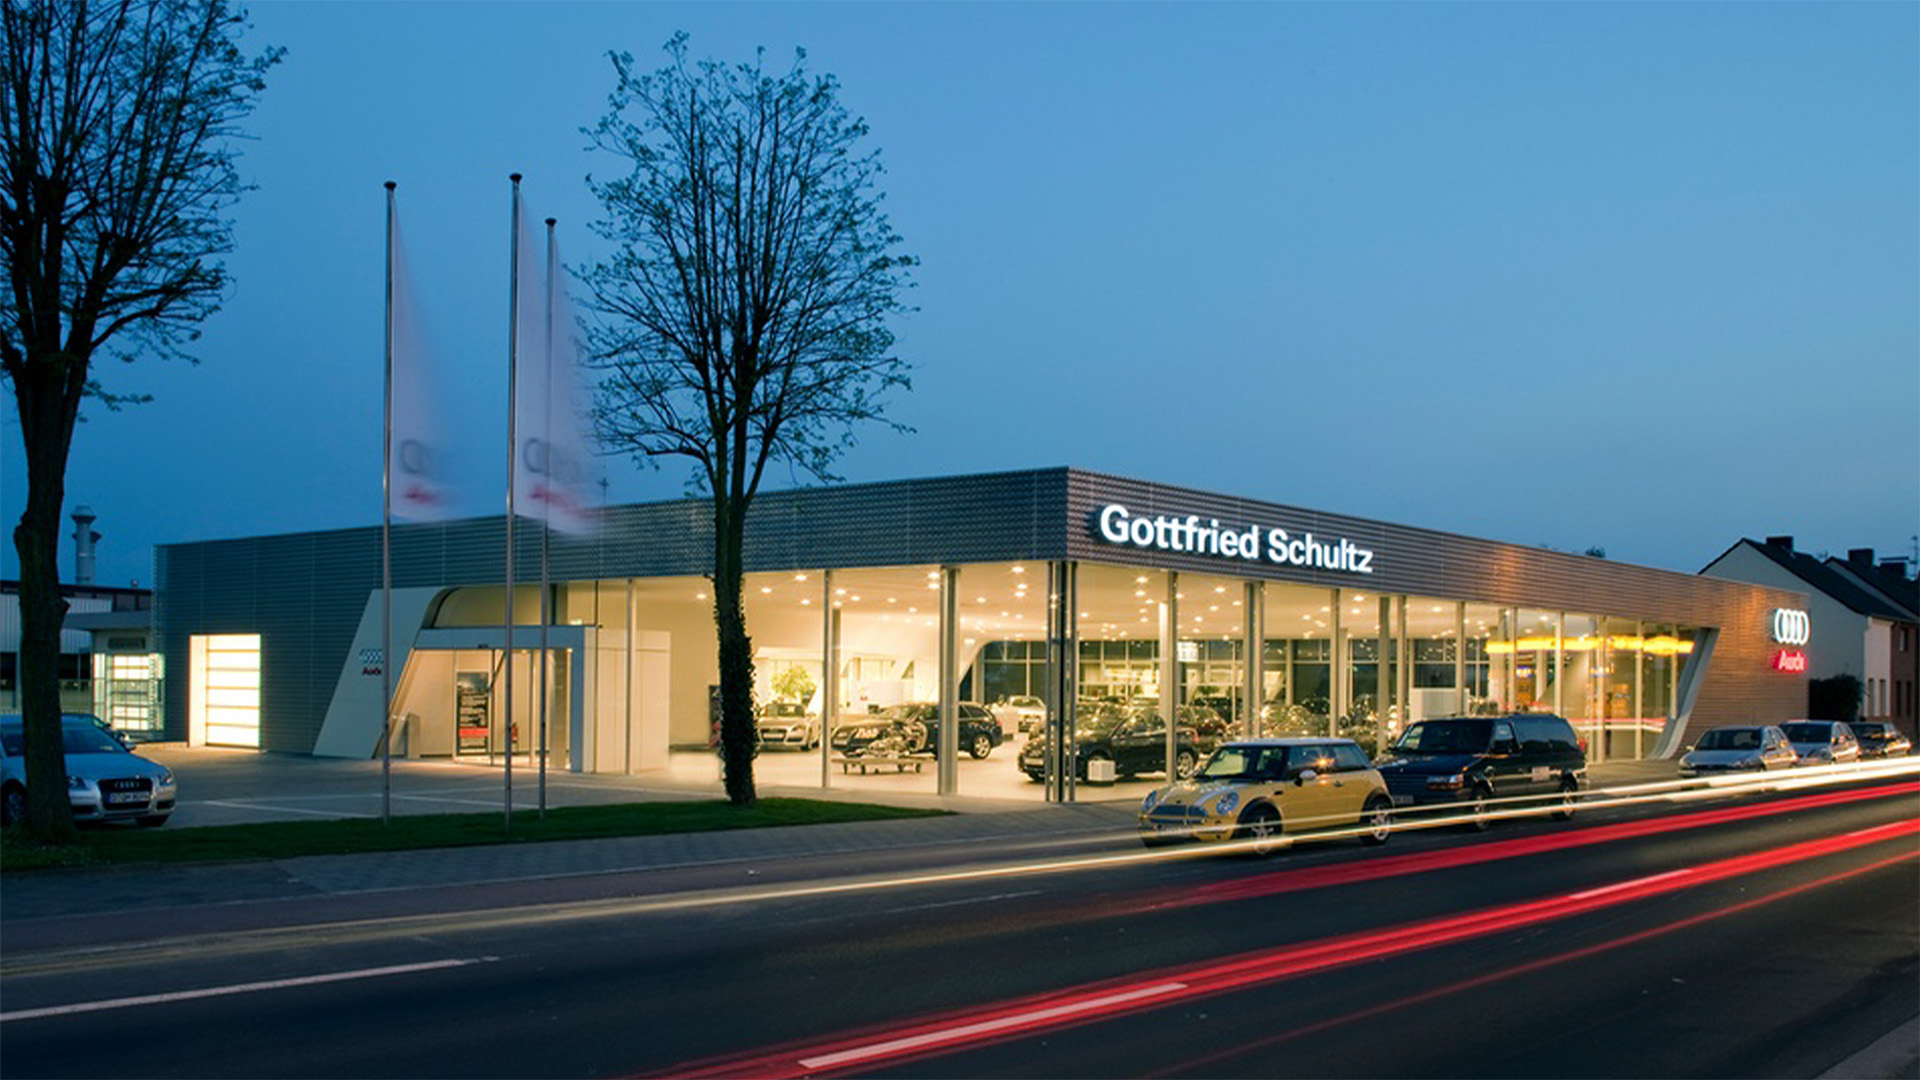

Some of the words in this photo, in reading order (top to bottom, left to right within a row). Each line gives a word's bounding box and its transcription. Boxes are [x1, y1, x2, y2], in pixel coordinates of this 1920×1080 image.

[1100, 504, 1259, 559] Gottfried
[1268, 528, 1373, 573] Schultz
[1777, 649, 1808, 671] Audi
